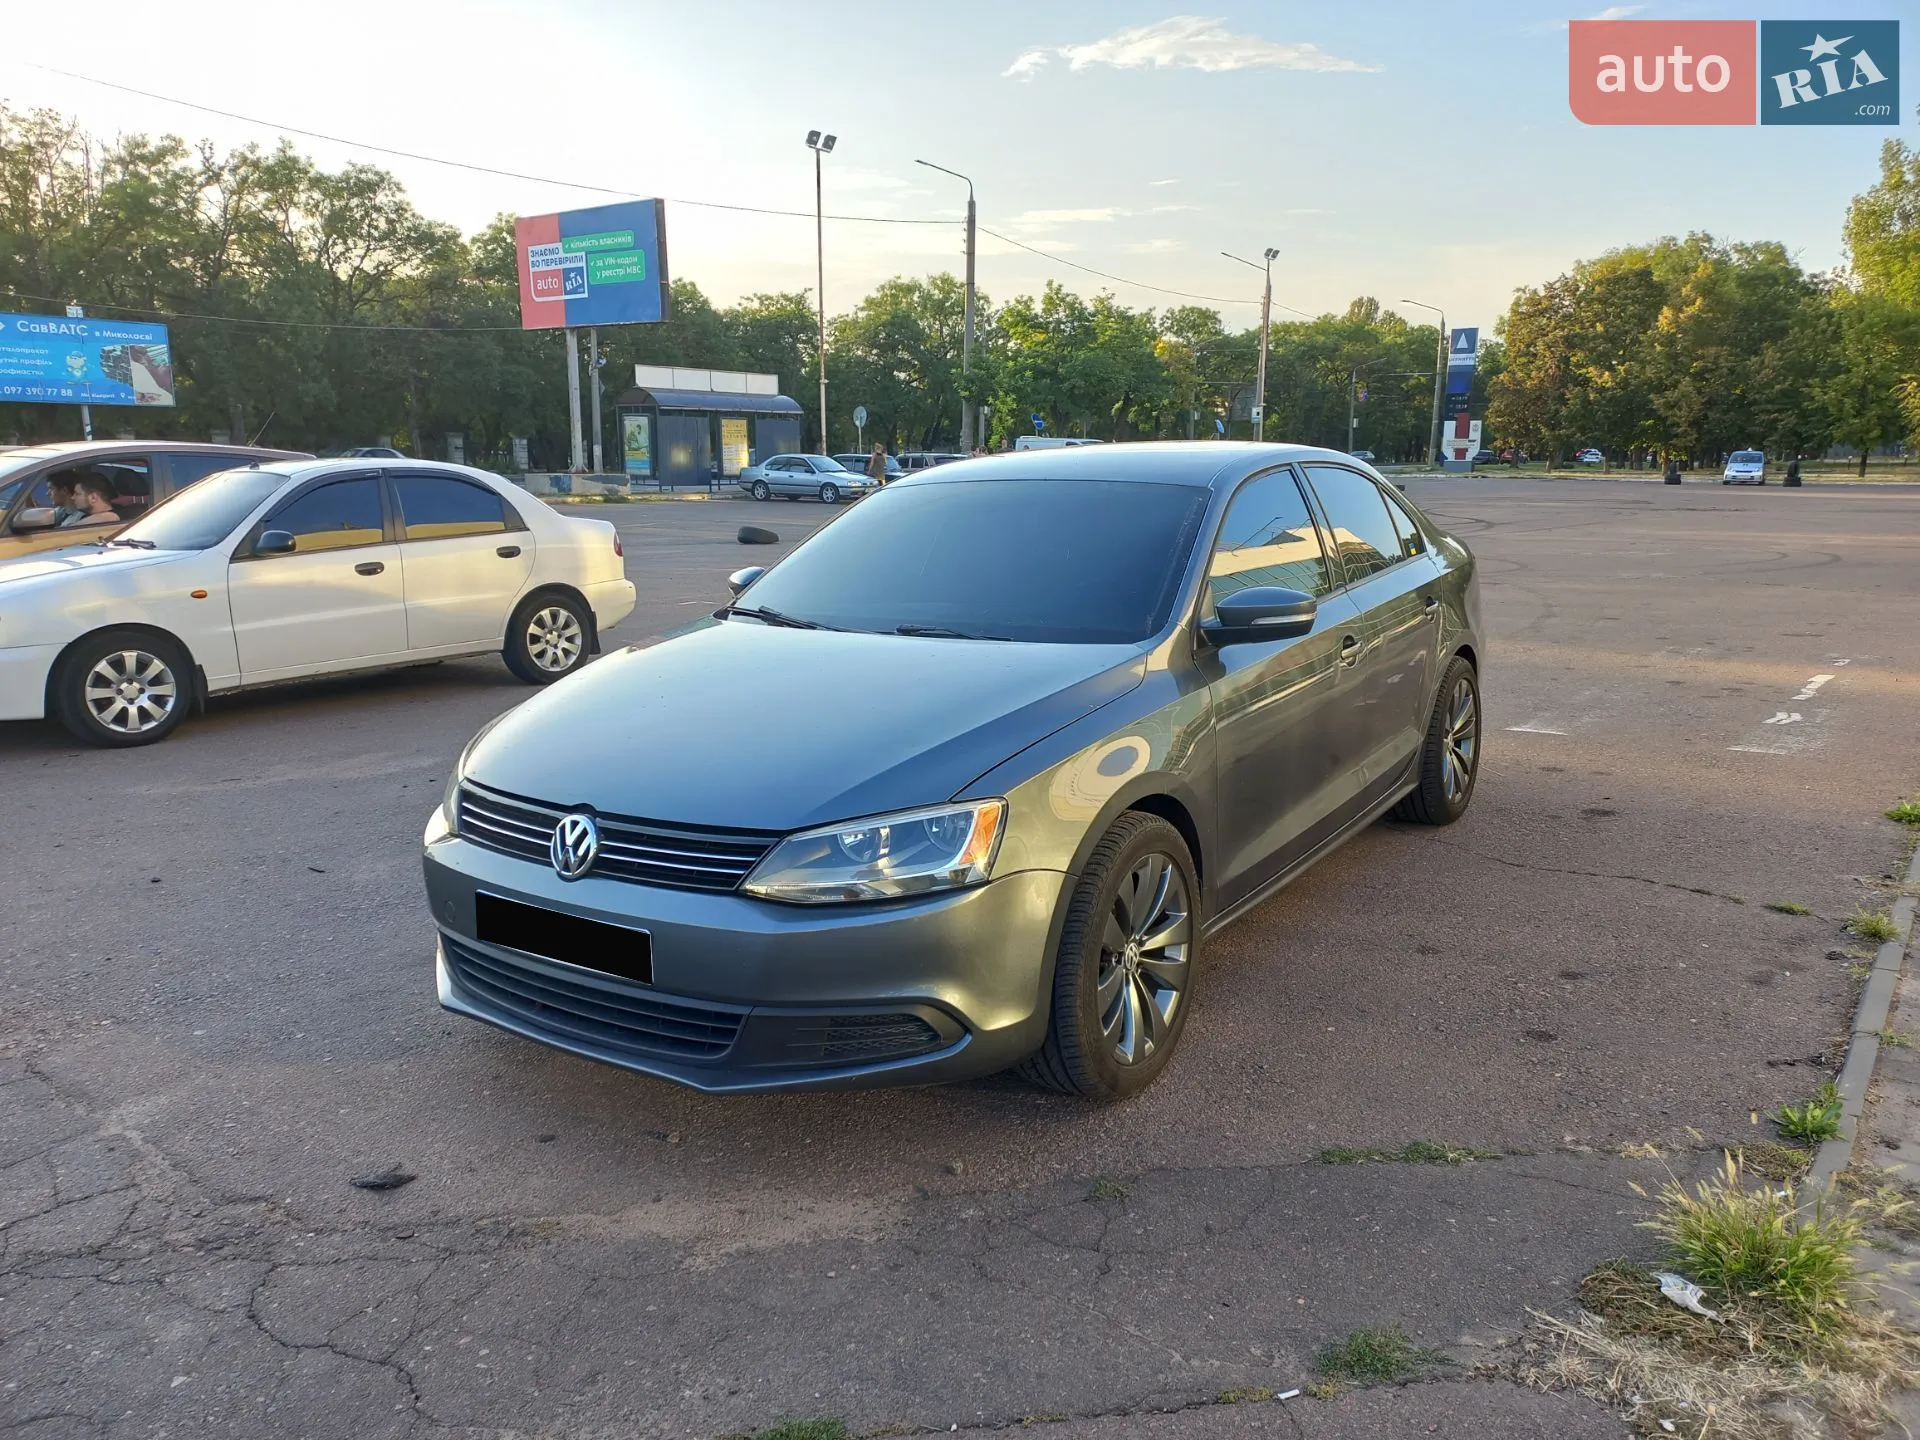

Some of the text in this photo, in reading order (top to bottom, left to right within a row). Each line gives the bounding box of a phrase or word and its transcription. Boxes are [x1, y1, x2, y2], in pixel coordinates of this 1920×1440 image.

[570, 233, 632, 249] кількість власників
[530, 247, 560, 258] ЗНАЄМО
[531, 255, 584, 268] БО ПЕРЕВІРИЛИ
[604, 256, 638, 267] VIN-кодом
[602, 268, 626, 278] реєстрі
[626, 266, 642, 275] МВС
[536, 277, 559, 290] auto
[16, 320, 89, 336] СавВАТС
[102, 330, 153, 341] Миколаєві
[3, 386, 23, 395] 097
[25, 387, 44, 396] 390
[46, 388, 58, 396] 77
[60, 388, 73, 397] 88
